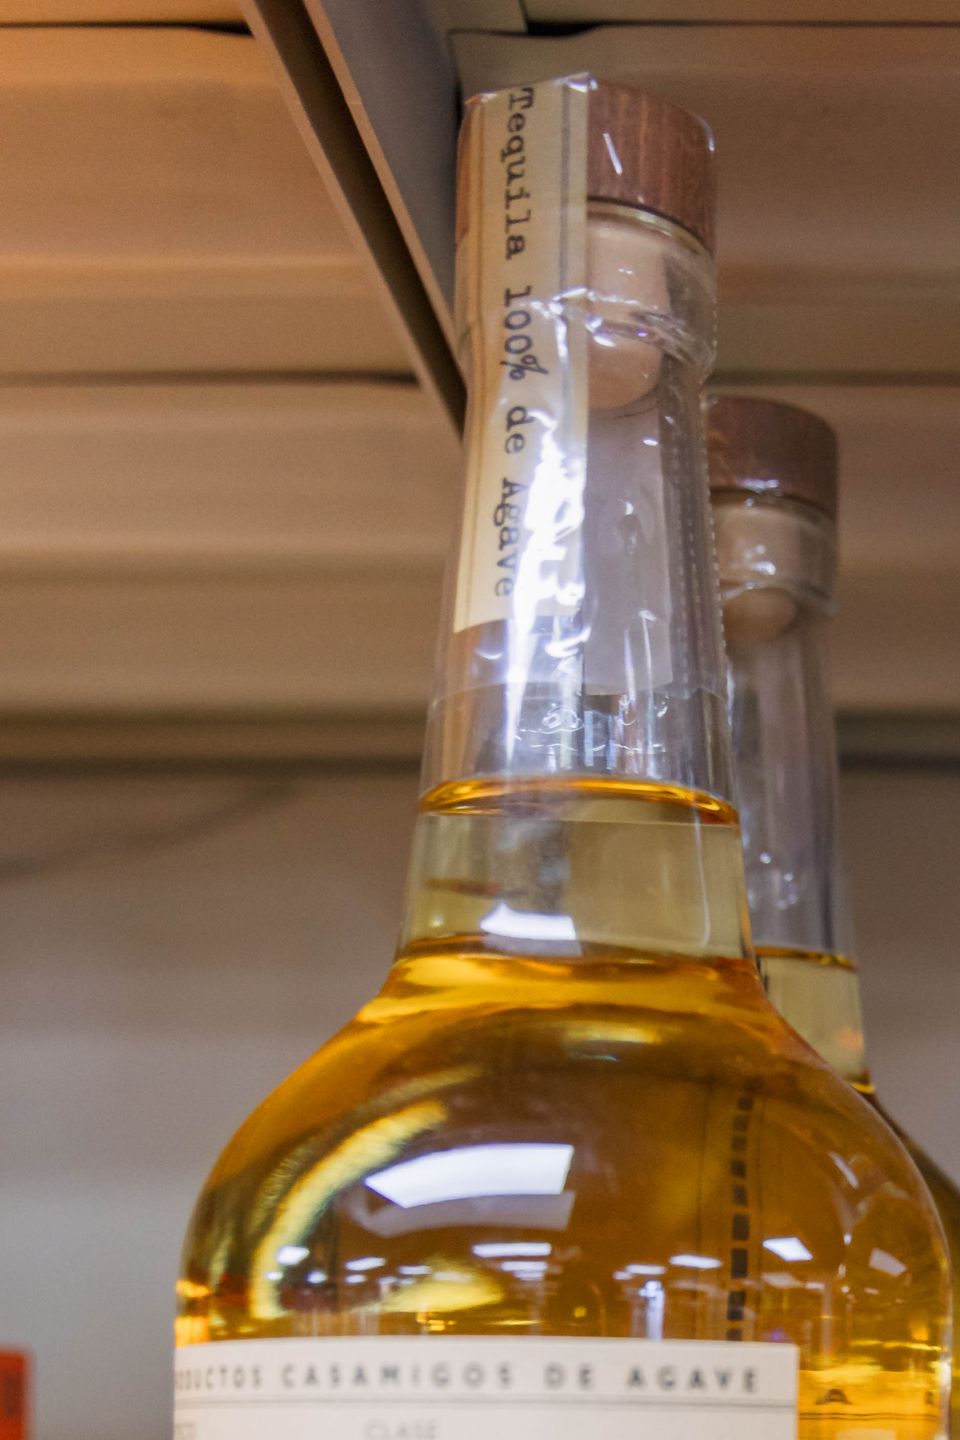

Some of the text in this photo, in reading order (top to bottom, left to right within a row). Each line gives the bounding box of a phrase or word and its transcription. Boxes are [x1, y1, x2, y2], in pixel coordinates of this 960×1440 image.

[492, 87, 549, 600] Tequila 100% de Agave
[282, 1361, 511, 1388] CASAMIGOS
[545, 1363, 592, 1389] DE
[627, 1365, 758, 1393] AGAVE
